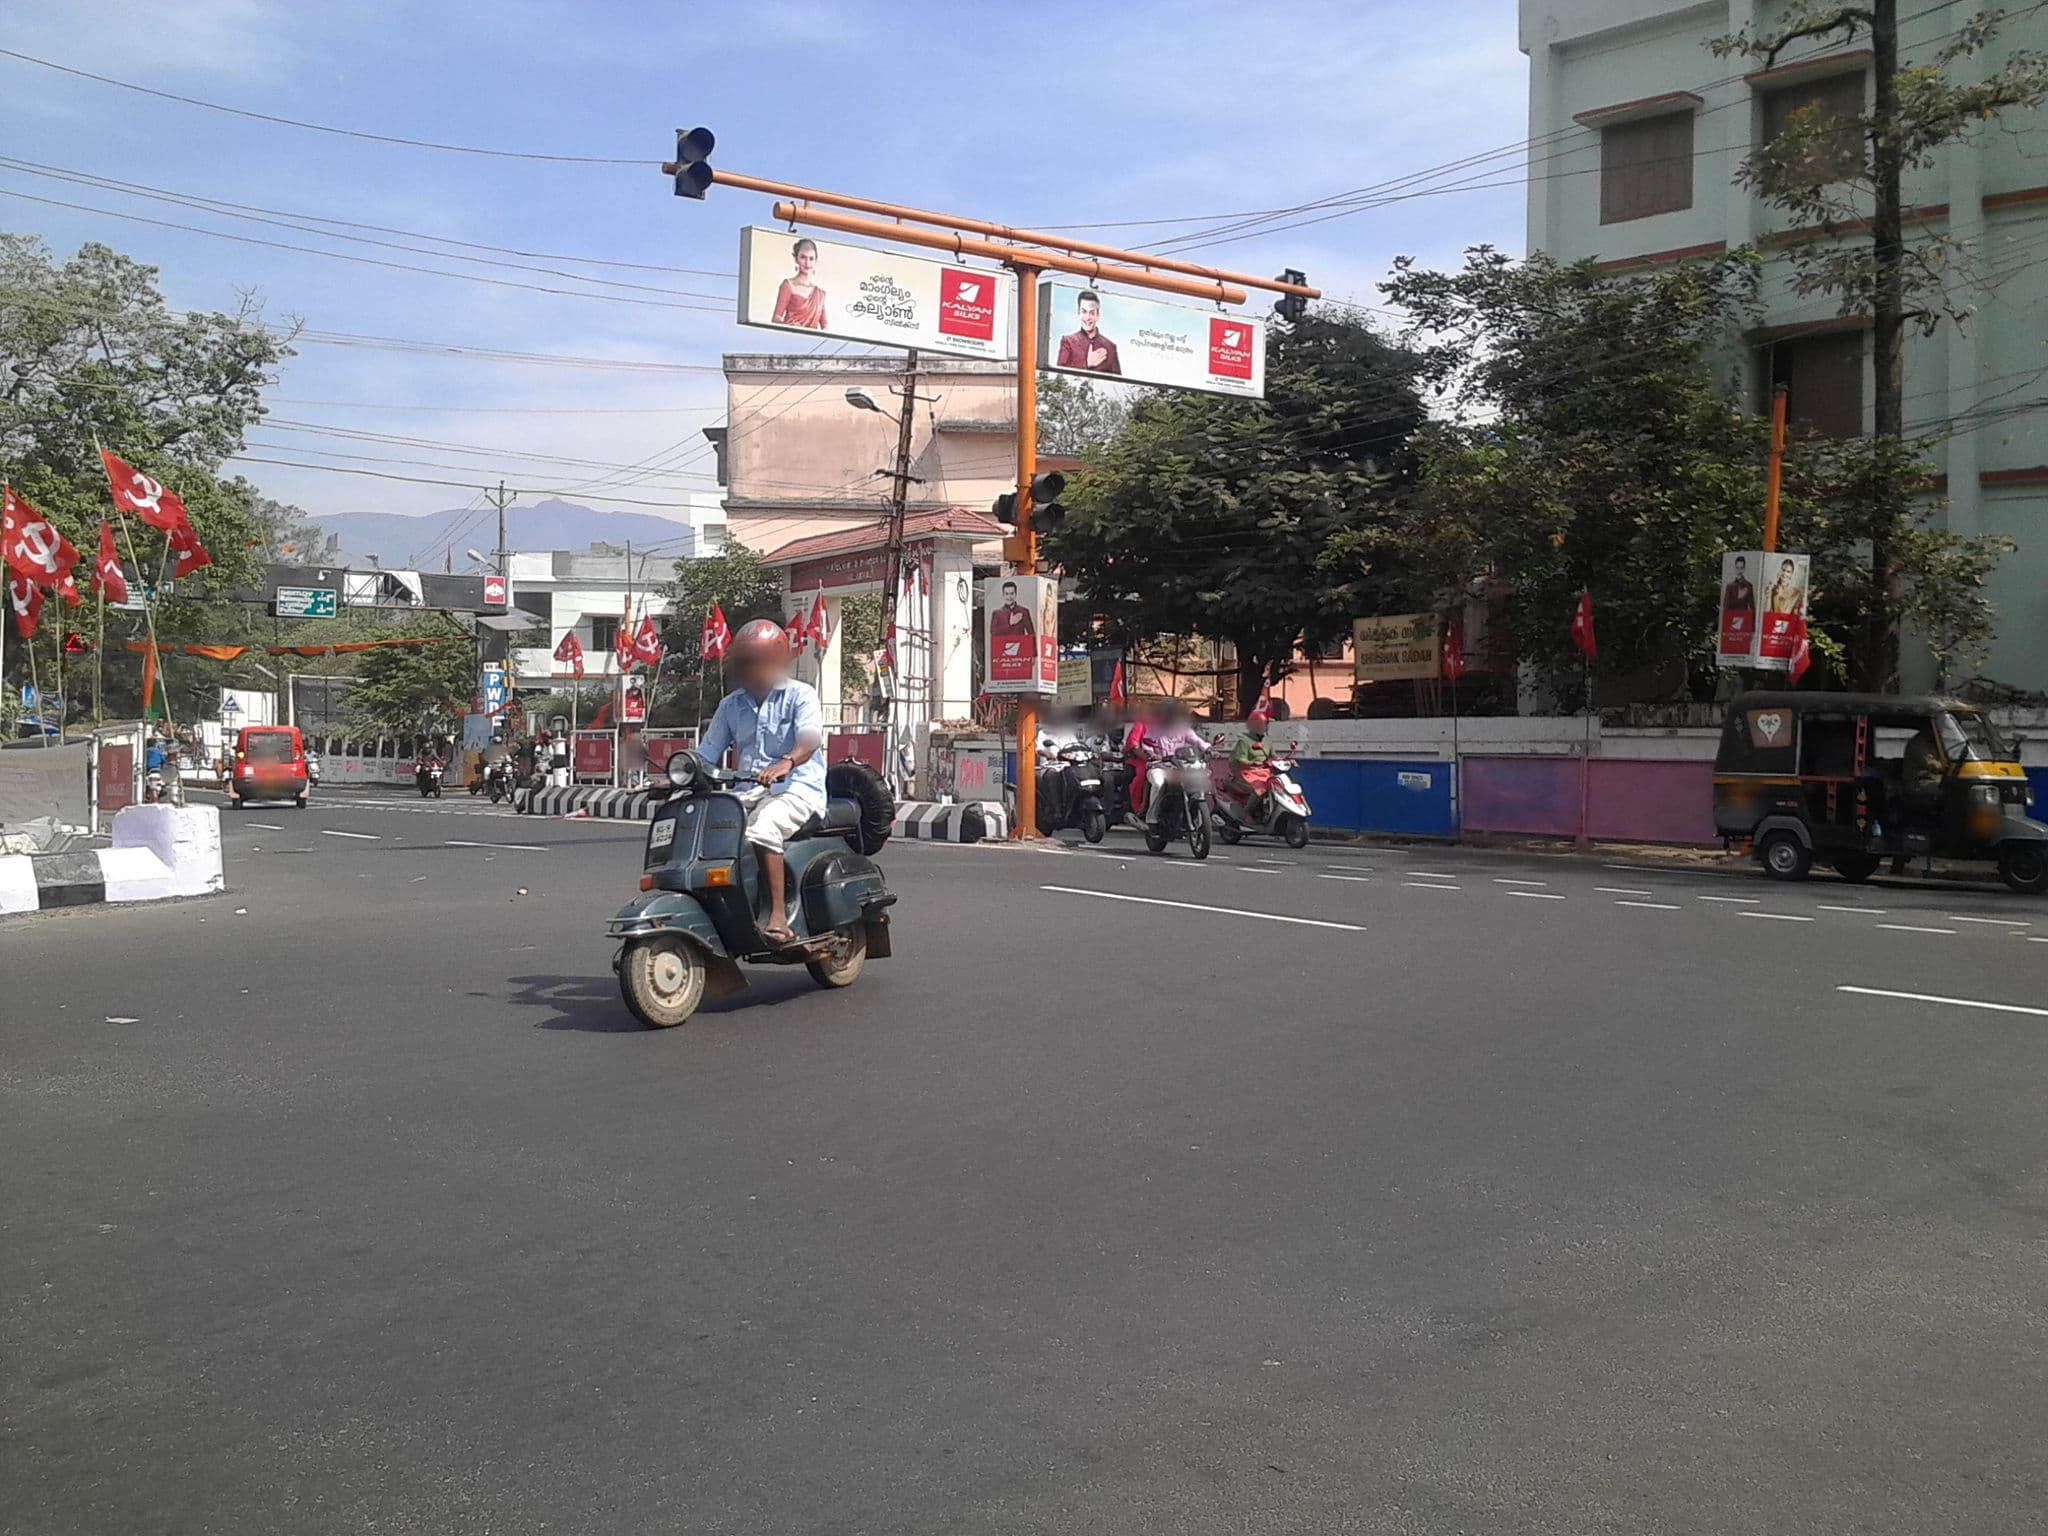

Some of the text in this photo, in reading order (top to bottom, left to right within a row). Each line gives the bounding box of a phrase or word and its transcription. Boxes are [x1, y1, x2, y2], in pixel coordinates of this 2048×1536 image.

[860, 282, 911, 298] മാംഗല്യം
[942, 300, 992, 315] KALYAN
[953, 310, 981, 320] SILKS
[1212, 346, 1250, 358] KALYAN
[1220, 354, 1242, 362] SILKS
[992, 656, 1031, 664] KALYAN
